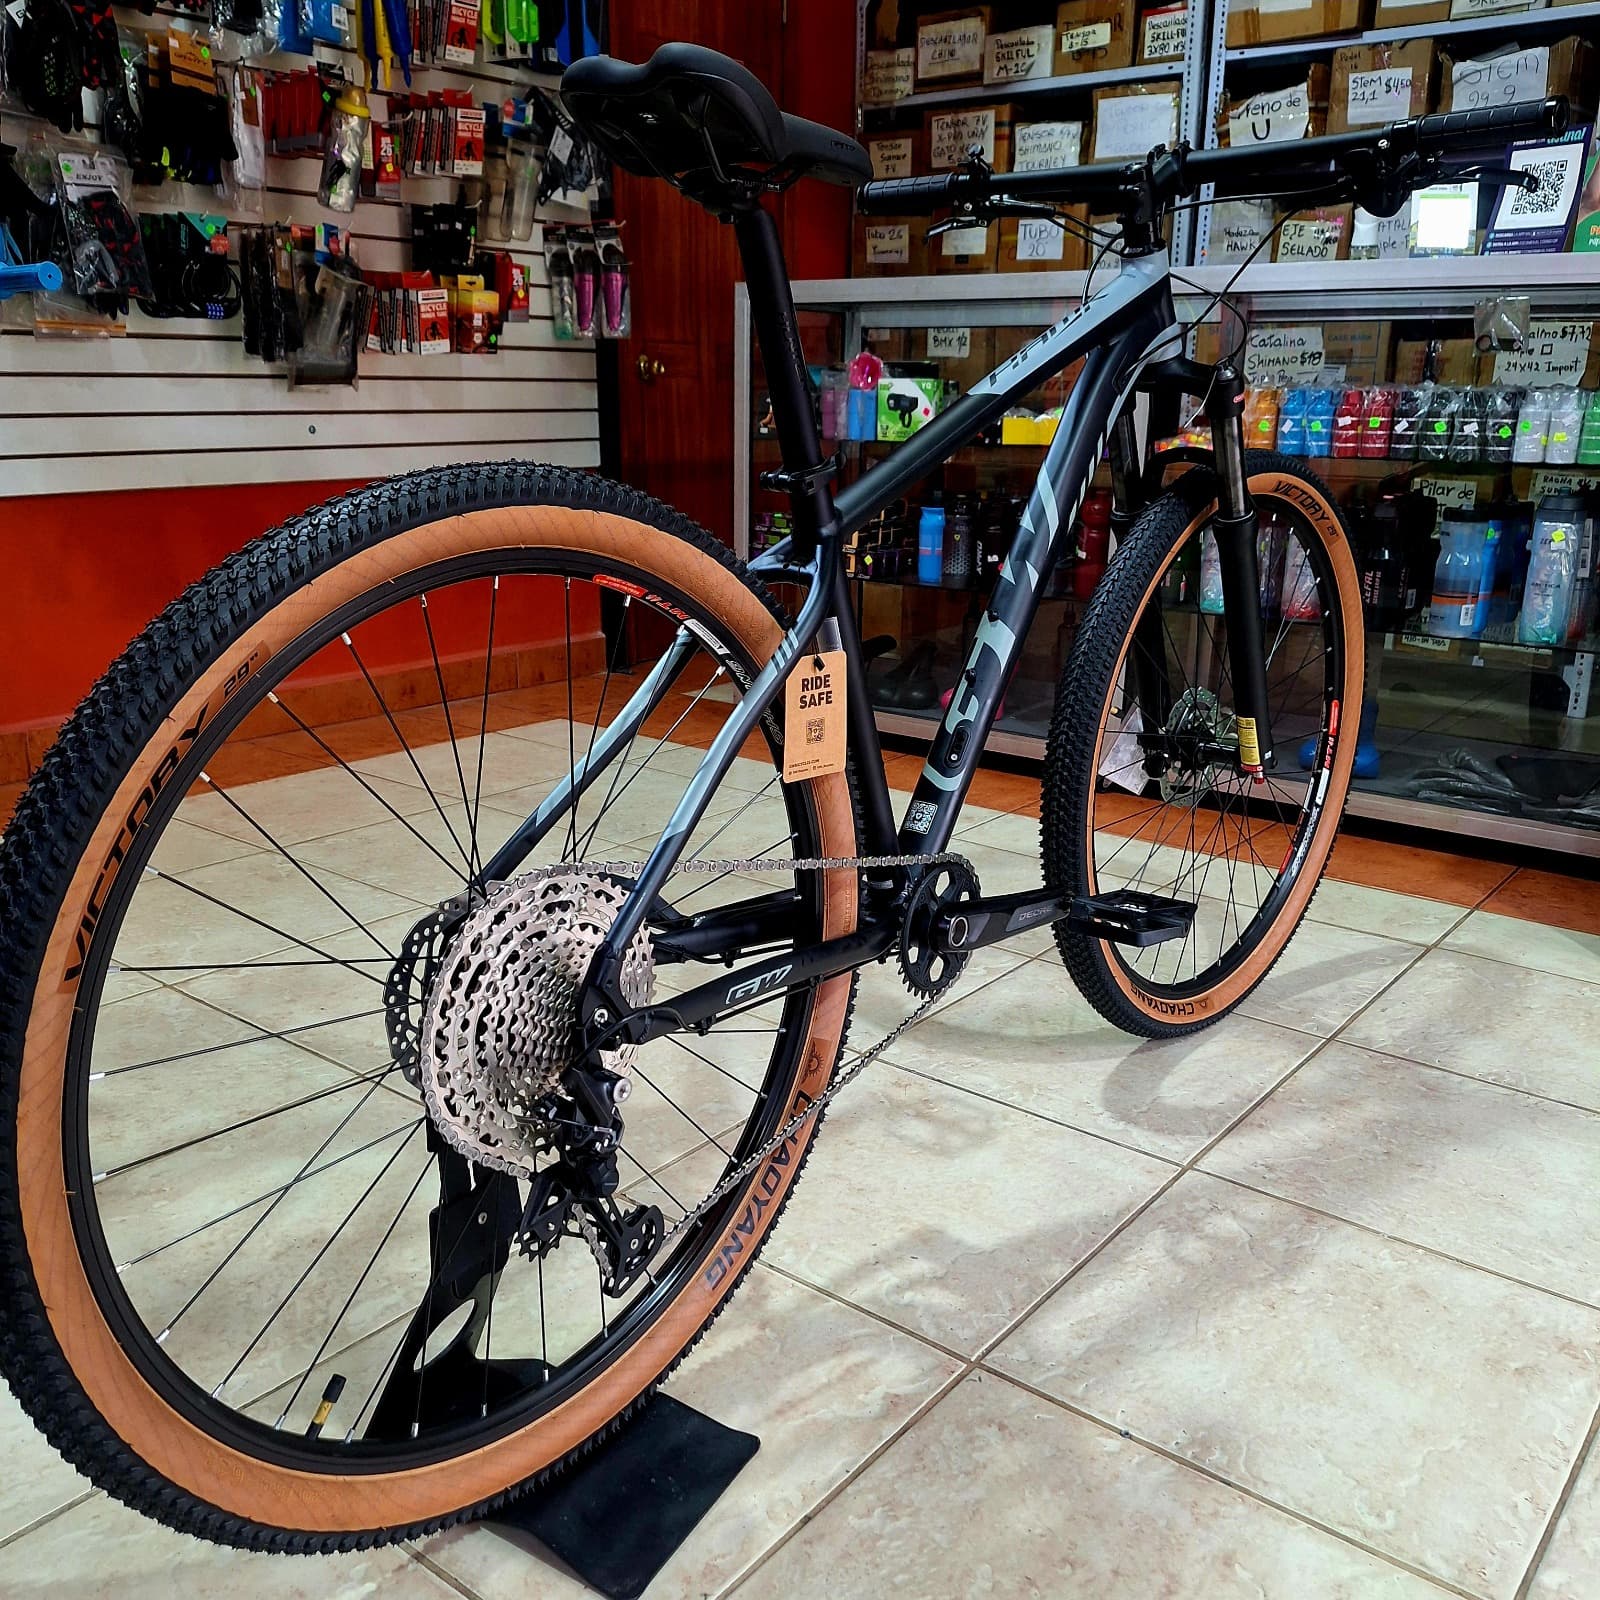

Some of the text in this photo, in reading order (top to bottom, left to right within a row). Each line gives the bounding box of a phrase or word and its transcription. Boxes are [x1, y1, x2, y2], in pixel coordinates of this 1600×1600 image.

[1286, 93, 1301, 108] de
[1251, 118, 1271, 140] U
[1020, 223, 1060, 240] TUBO
[1281, 242, 1329, 258] SELLADO
[1250, 333, 1306, 348] Catalina
[1299, 351, 1322, 367] $18
[1544, 357, 1581, 376] Import
[1420, 478, 1475, 500] Pilar de
[1272, 480, 1330, 523] VICTORY
[801, 674, 831, 692] RIDE
[799, 690, 833, 709] SAFE
[63, 651, 259, 982] VICTORY 29"
[1130, 982, 1195, 1016] CHAOYANG
